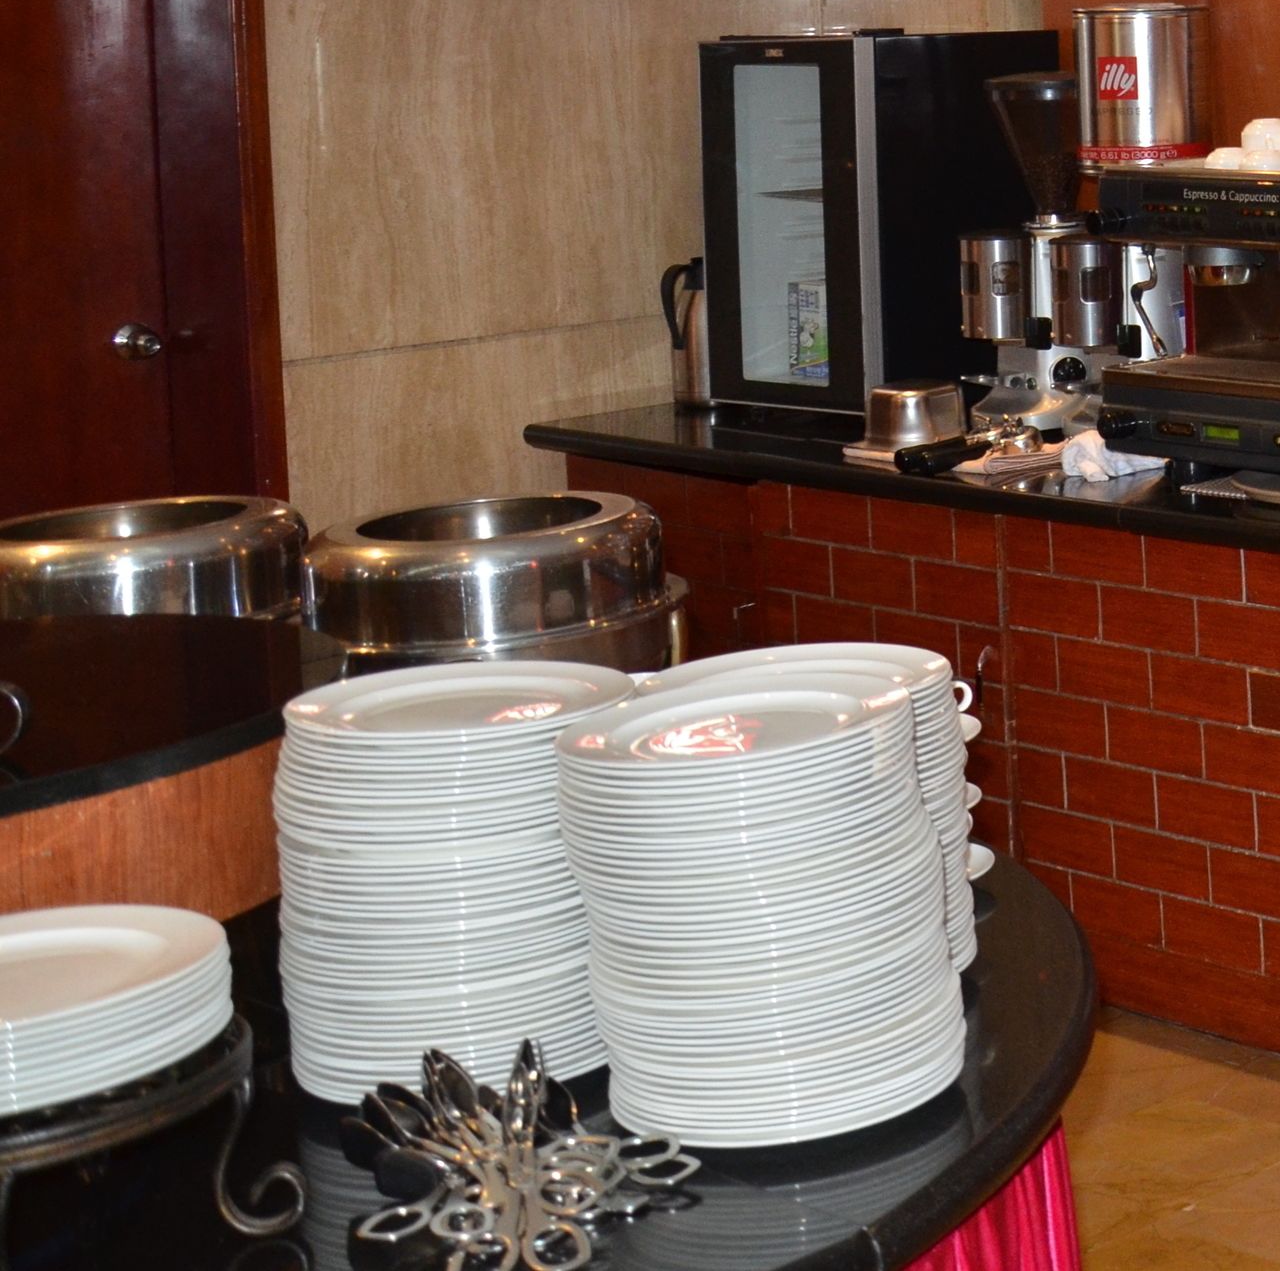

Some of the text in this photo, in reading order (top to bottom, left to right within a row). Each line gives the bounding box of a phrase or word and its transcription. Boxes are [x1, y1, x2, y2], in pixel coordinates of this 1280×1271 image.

[1100, 63, 1136, 97] illy
[1120, 151, 1130, 160] lb
[1131, 150, 1159, 161] (3000
[1183, 188, 1218, 201] Espresso
[1220, 190, 1227, 201] &
[1228, 190, 1280, 205] Cappuccino:
